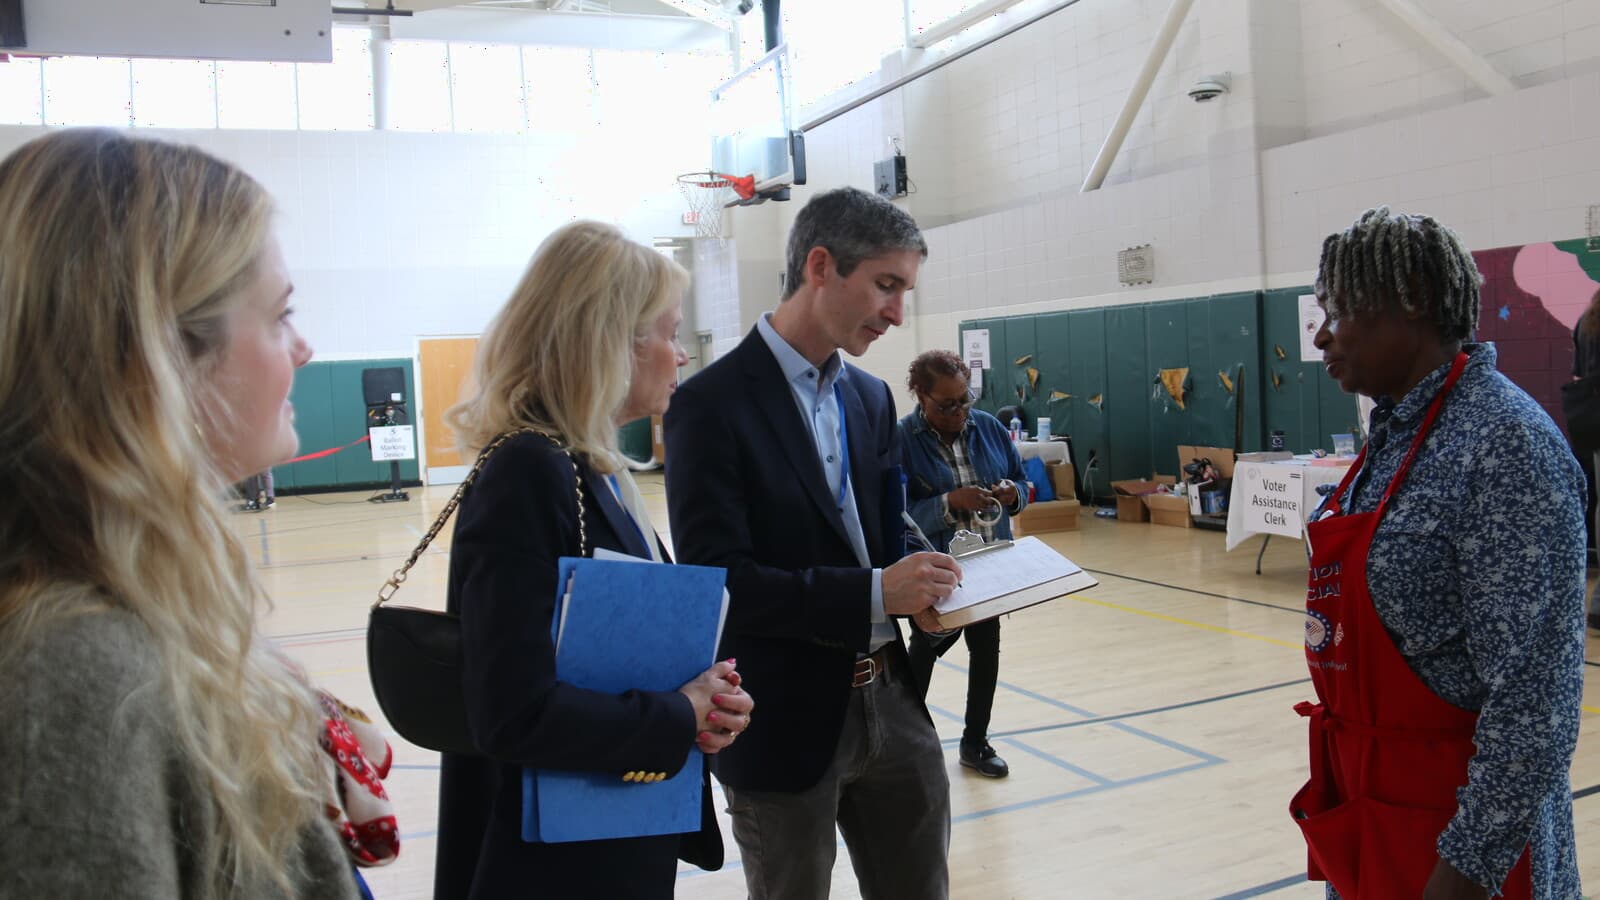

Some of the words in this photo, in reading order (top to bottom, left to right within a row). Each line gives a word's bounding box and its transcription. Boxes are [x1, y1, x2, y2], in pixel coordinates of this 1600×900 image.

[1262, 478, 1287, 492] Voter
[1252, 494, 1297, 511] Assistance
[1264, 511, 1287, 526] Clerk
